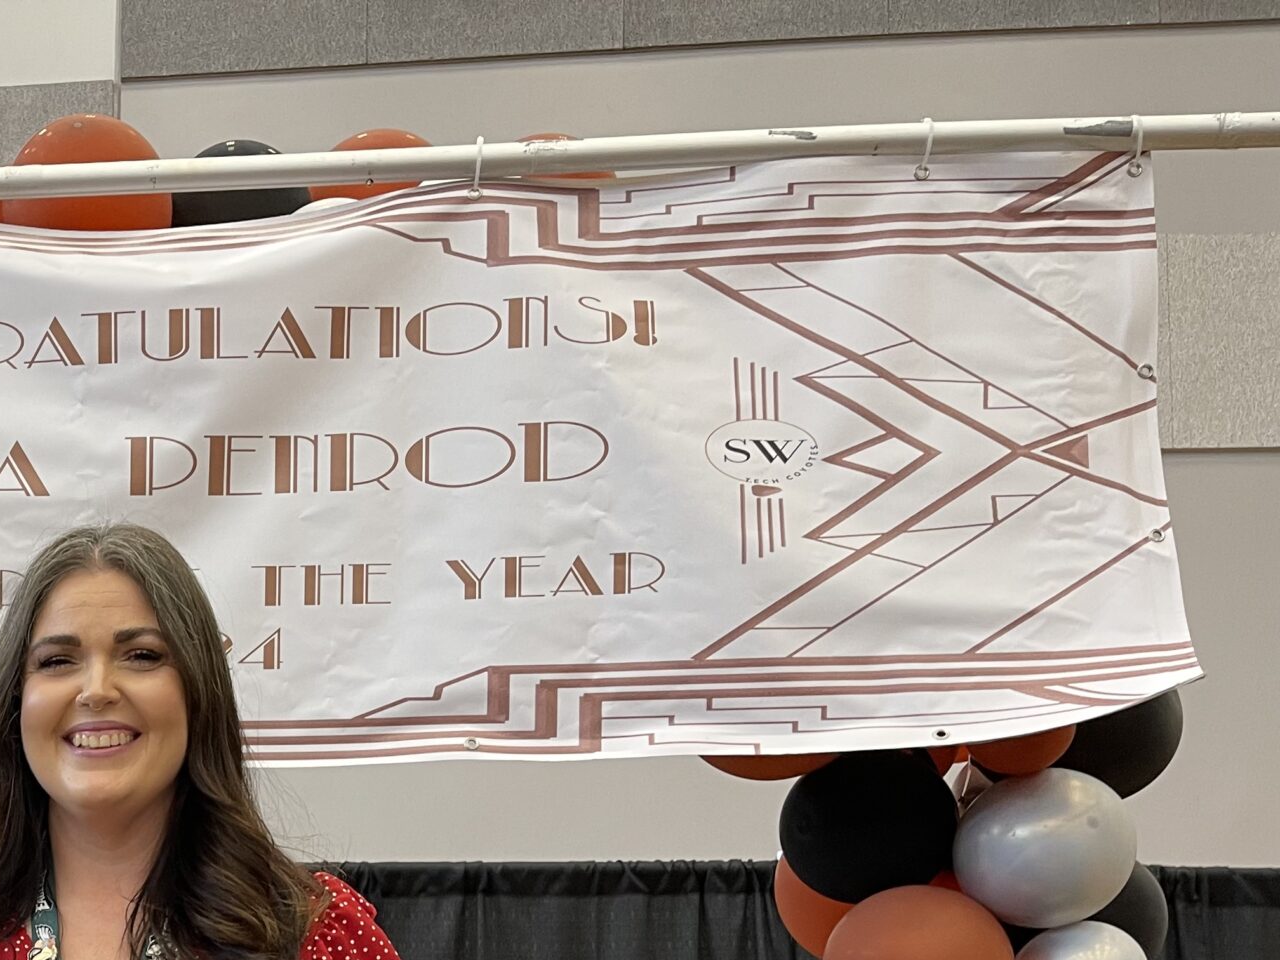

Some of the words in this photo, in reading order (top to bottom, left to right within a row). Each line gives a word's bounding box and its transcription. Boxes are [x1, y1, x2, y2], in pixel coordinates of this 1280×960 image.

[125, 421, 609, 496] PENROD
[723, 438, 808, 465] SW
[785, 444, 819, 481] COYOTES
[251, 563, 392, 606] THE
[445, 552, 666, 601] YEAR
